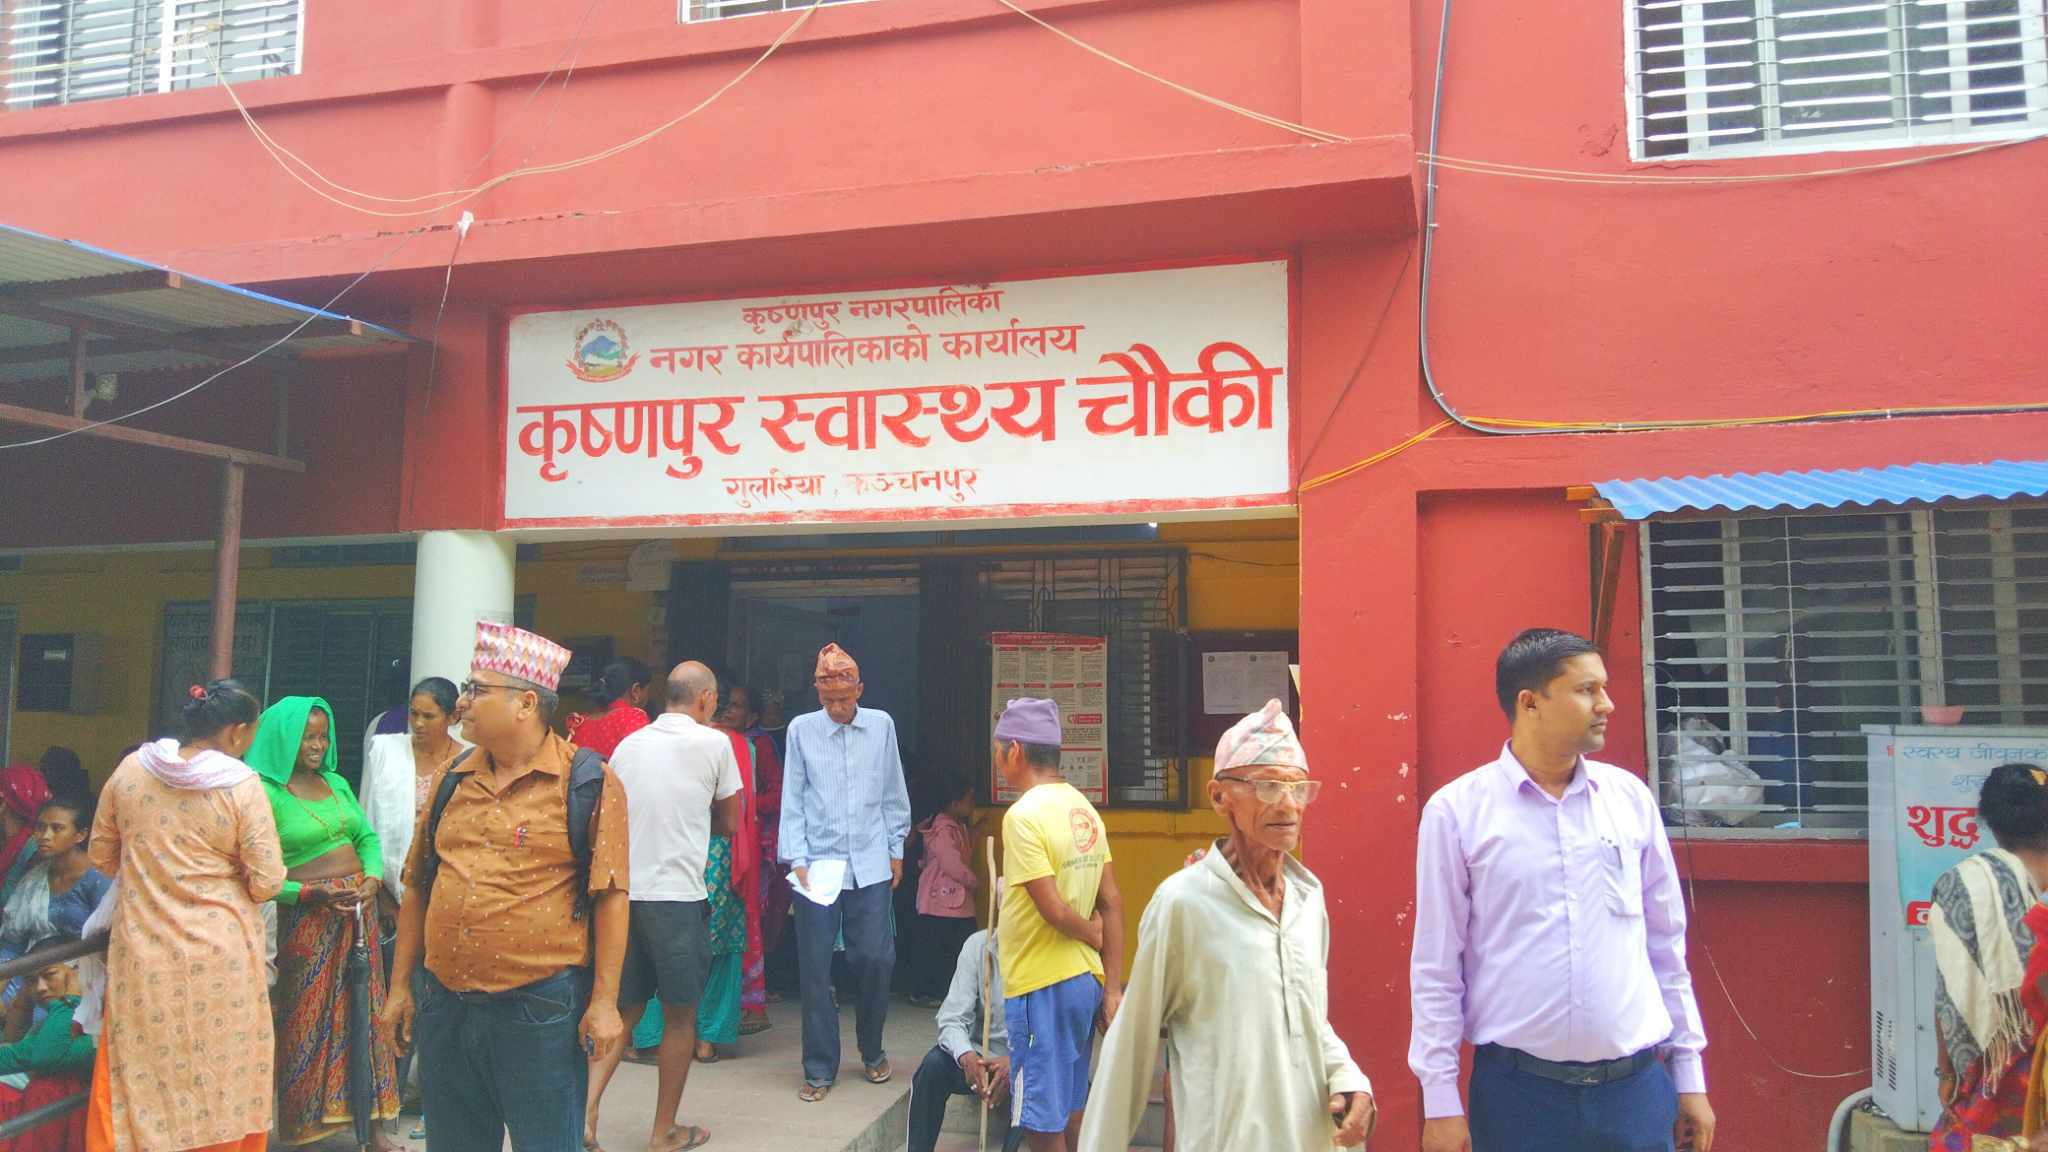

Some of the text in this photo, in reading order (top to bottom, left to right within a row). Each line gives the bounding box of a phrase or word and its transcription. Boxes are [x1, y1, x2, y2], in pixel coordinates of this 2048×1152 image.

[742, 287, 1004, 334] कृष्णपुर नगरपालिका
[650, 319, 1085, 375] नगर कार्यपालिकाको कार्यालय
[516, 341, 1283, 482] कृष्णपुर स्वास्थ्य चौकी
